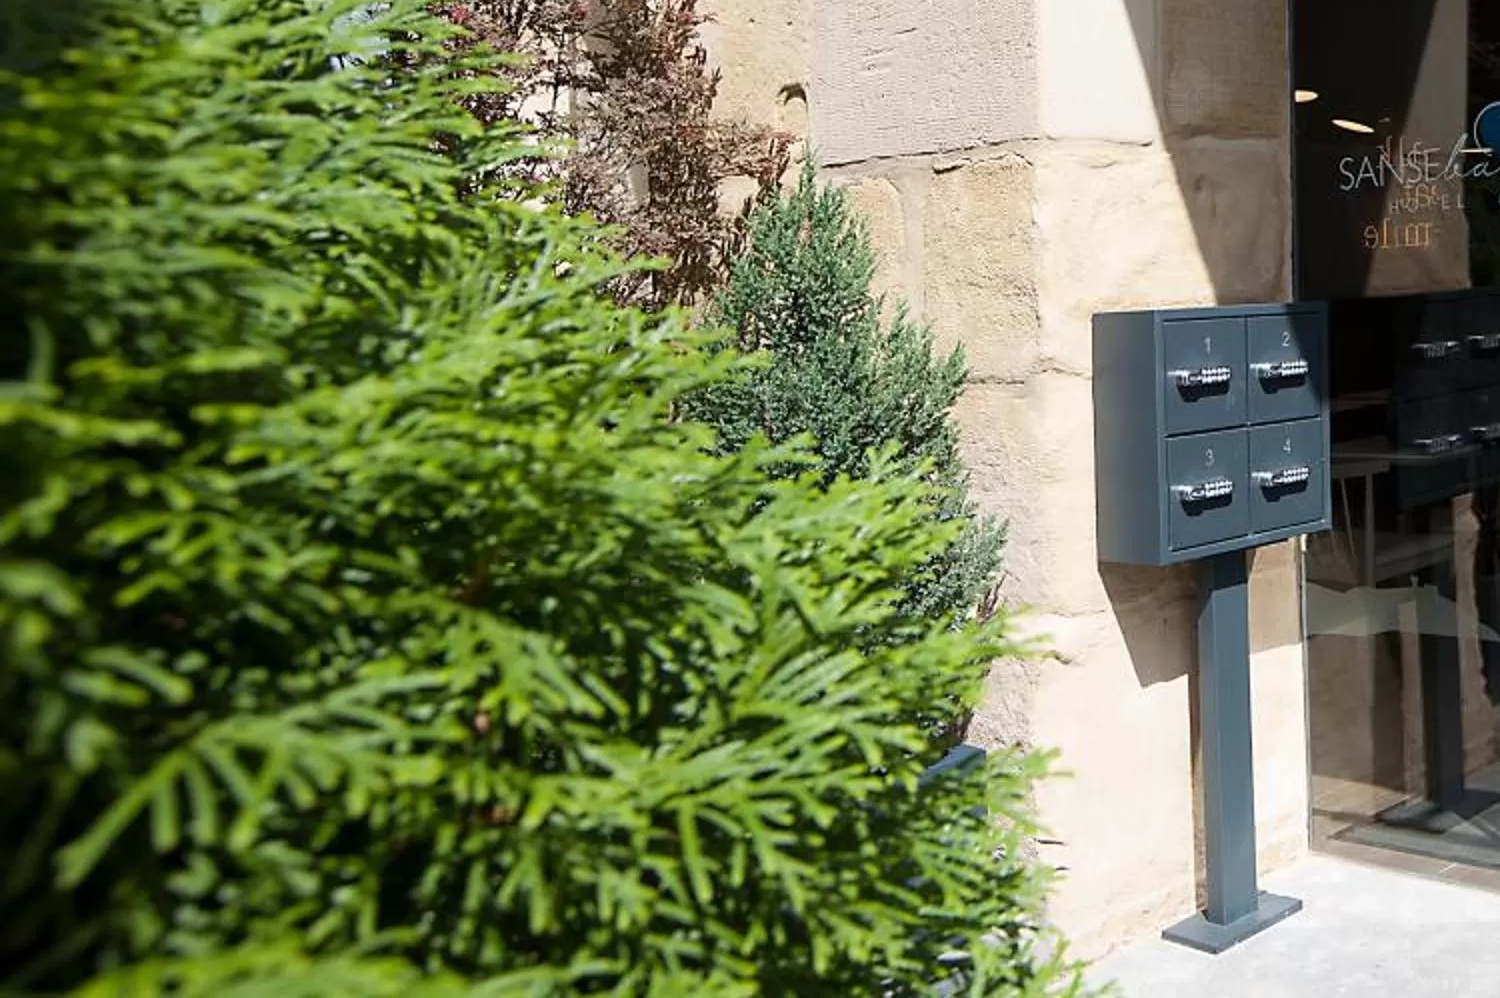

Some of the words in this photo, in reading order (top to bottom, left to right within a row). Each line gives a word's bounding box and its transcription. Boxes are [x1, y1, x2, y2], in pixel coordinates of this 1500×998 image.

[1203, 336, 1212, 354] 1
[1281, 330, 1291, 347] 2
[1282, 437, 1292, 454] 4
